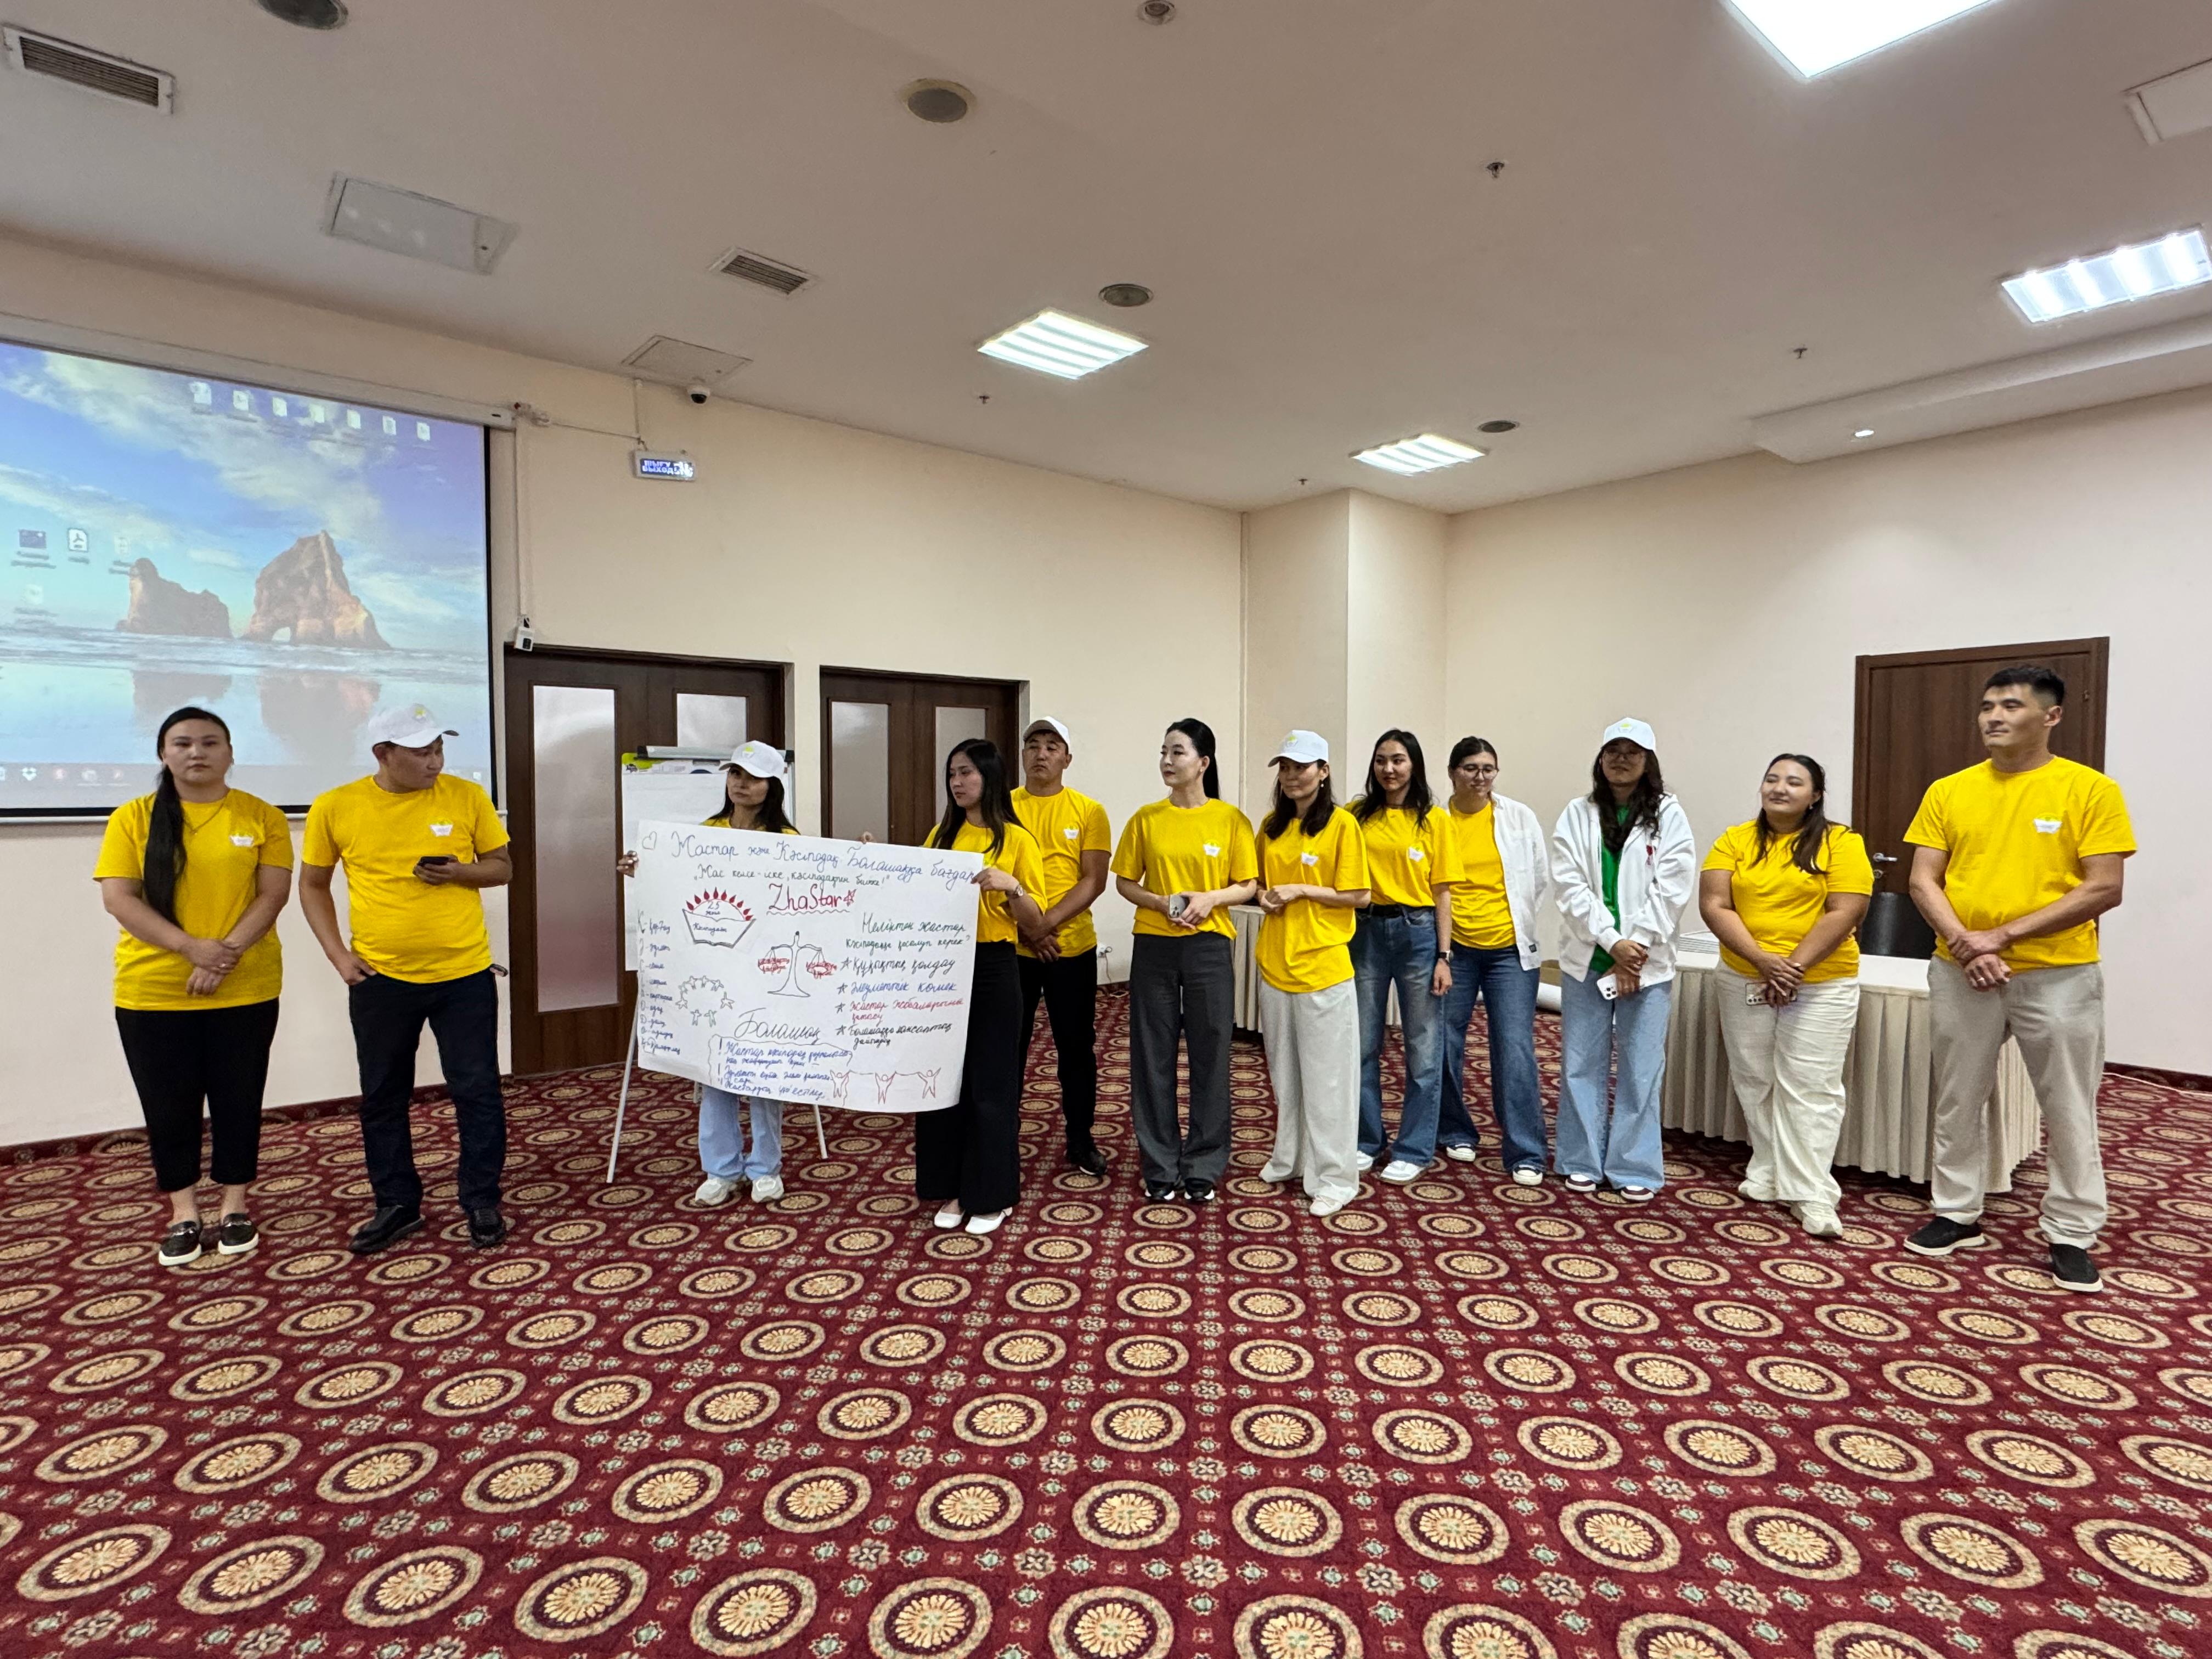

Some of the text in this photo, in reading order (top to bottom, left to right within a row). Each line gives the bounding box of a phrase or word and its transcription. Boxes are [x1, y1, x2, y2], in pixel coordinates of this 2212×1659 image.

[642, 465, 674, 475] ВЫХОД
[671, 831, 739, 861] Жастар
[768, 883, 842, 911] ZhaStar
[734, 1007, 821, 1045] Болашақ
